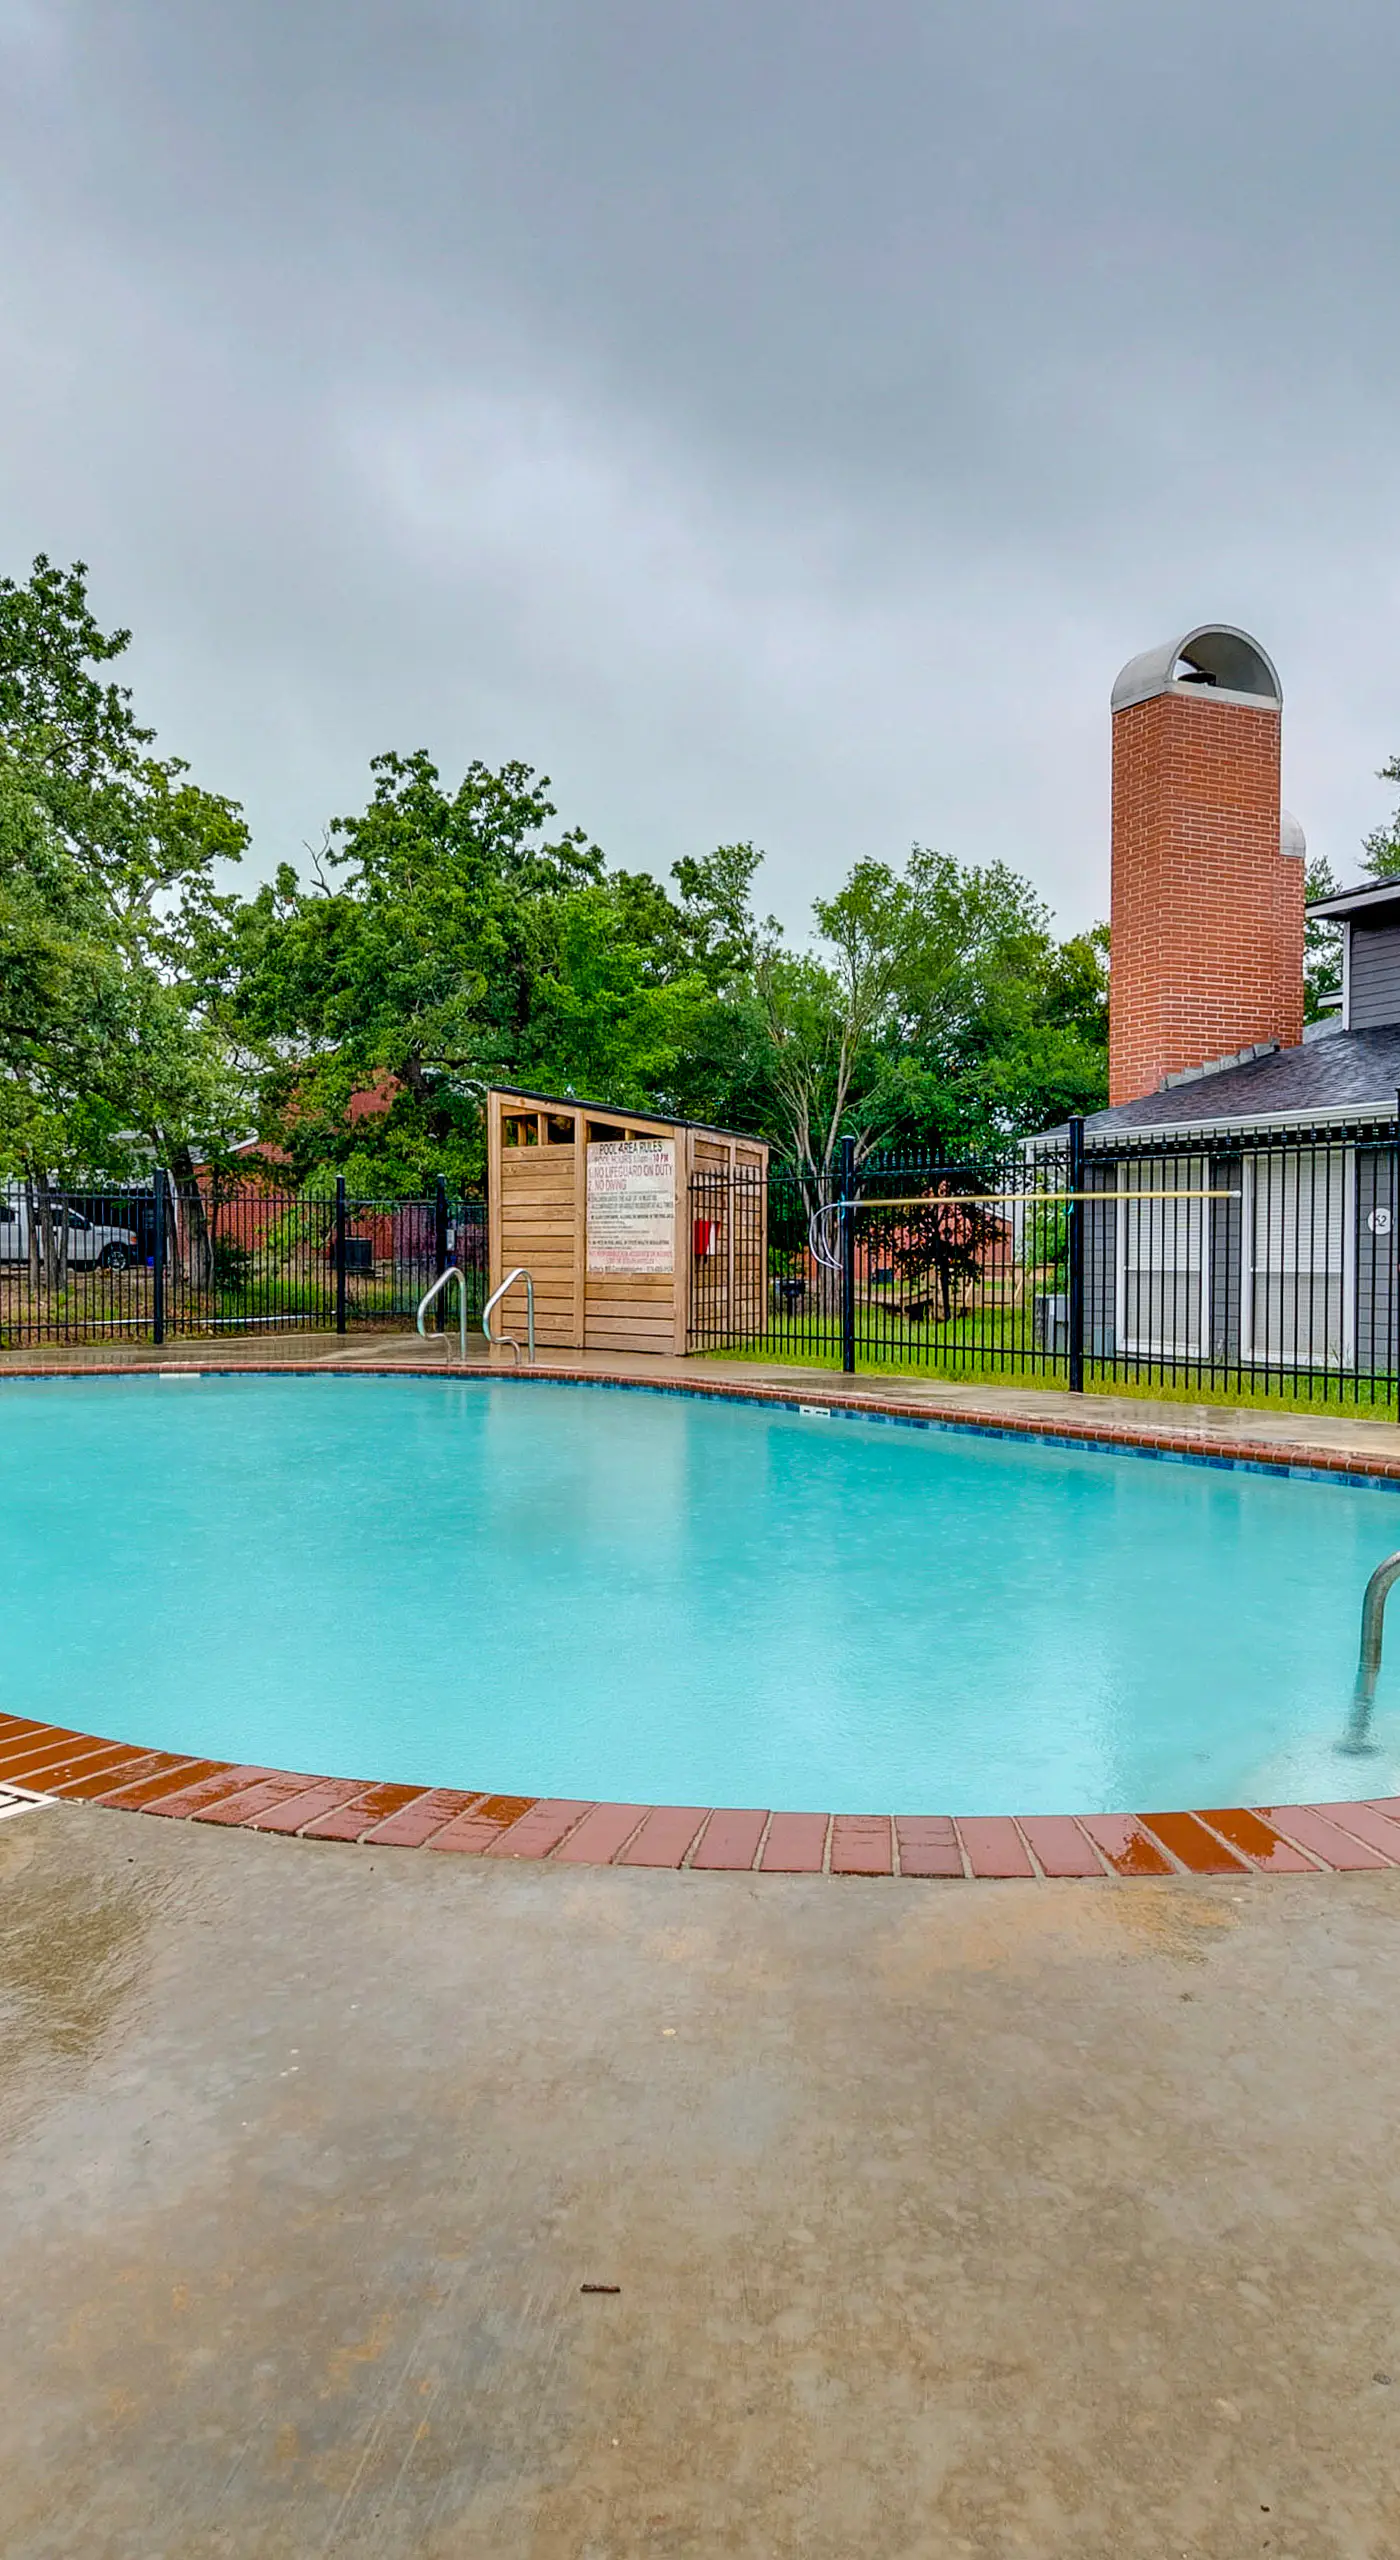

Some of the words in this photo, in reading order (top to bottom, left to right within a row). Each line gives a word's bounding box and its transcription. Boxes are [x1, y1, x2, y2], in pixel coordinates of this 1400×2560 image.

[600, 1143, 617, 1155] POOL
[618, 1142, 637, 1154] AREA
[639, 1140, 663, 1153] RULES
[611, 1155, 632, 1164] HOURS
[653, 1153, 660, 1162] 10
[660, 1153, 669, 1162] PM
[594, 1167, 604, 1179] NO
[605, 1165, 642, 1178] LIFEGUARD
[643, 1164, 654, 1176] ON
[655, 1163, 673, 1176] DUTY
[595, 1180, 604, 1191] NO
[605, 1179, 627, 1190] DIVING
